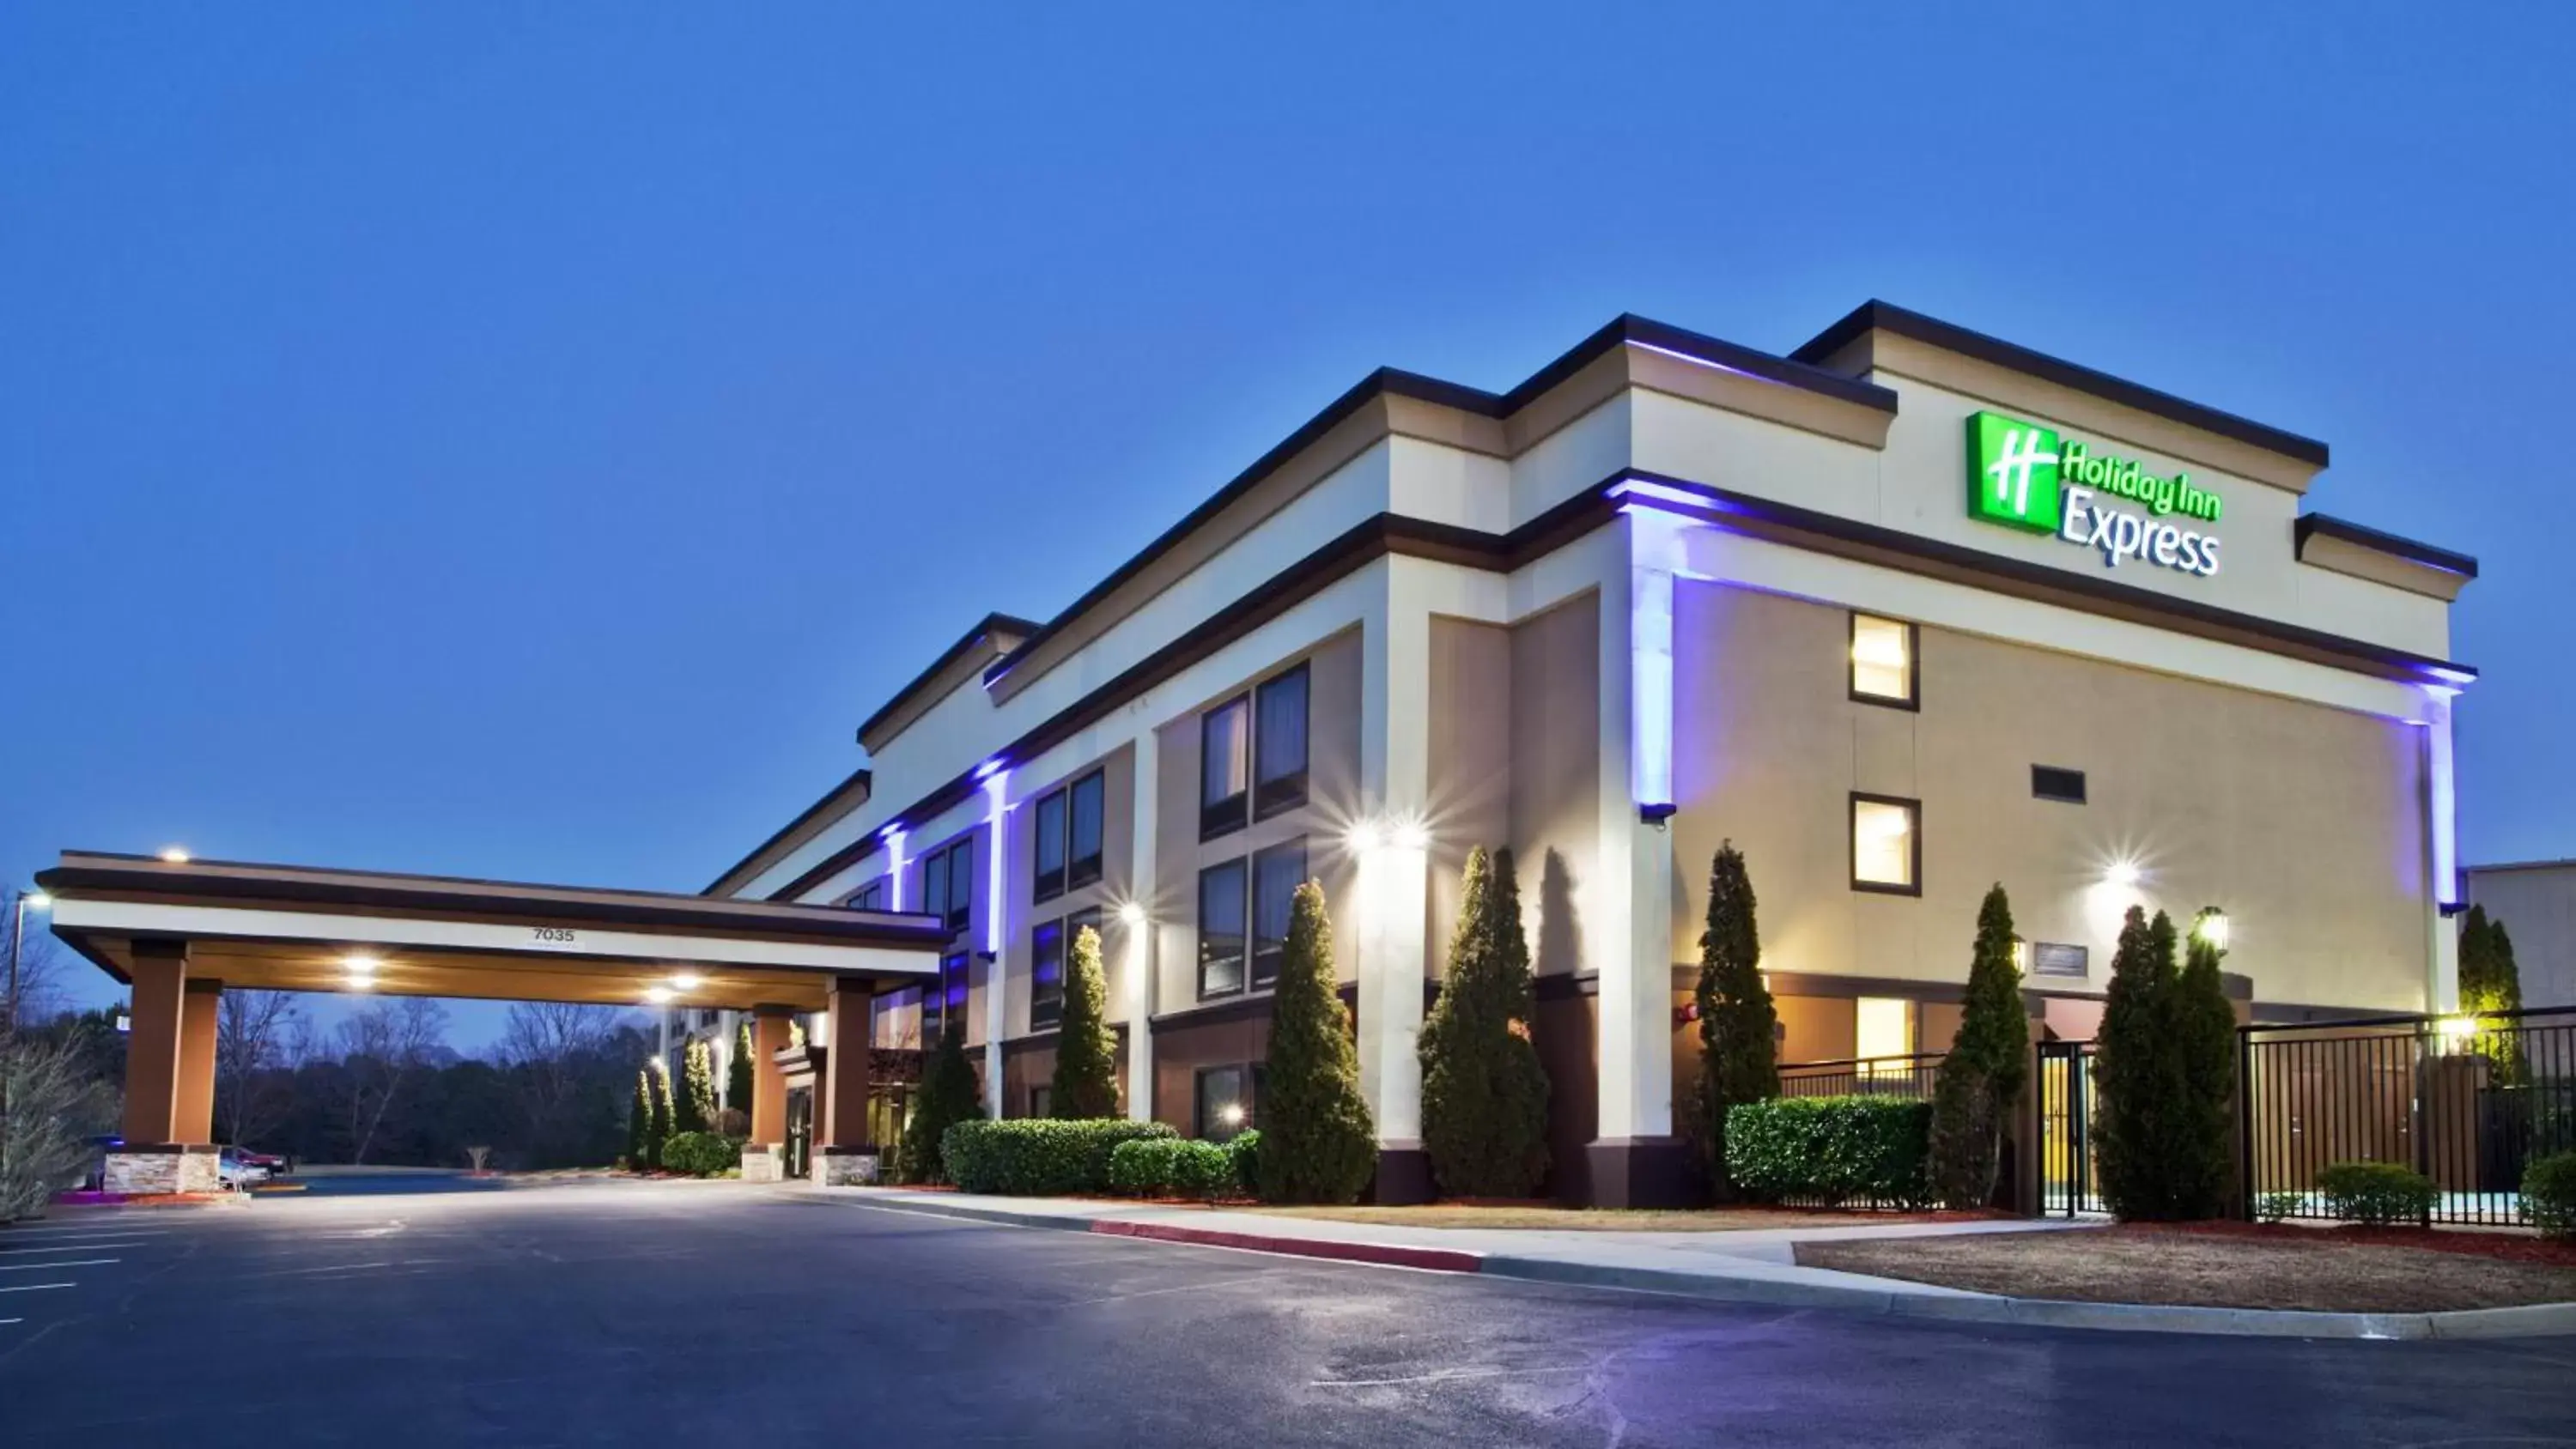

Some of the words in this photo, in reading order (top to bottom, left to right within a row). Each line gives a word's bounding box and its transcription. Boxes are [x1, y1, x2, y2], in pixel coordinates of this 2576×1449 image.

[2063, 440, 2175, 514] Holiday
[2178, 474, 2222, 520] Inn
[2062, 487, 2221, 576] Express
[533, 928, 574, 942] 7035
